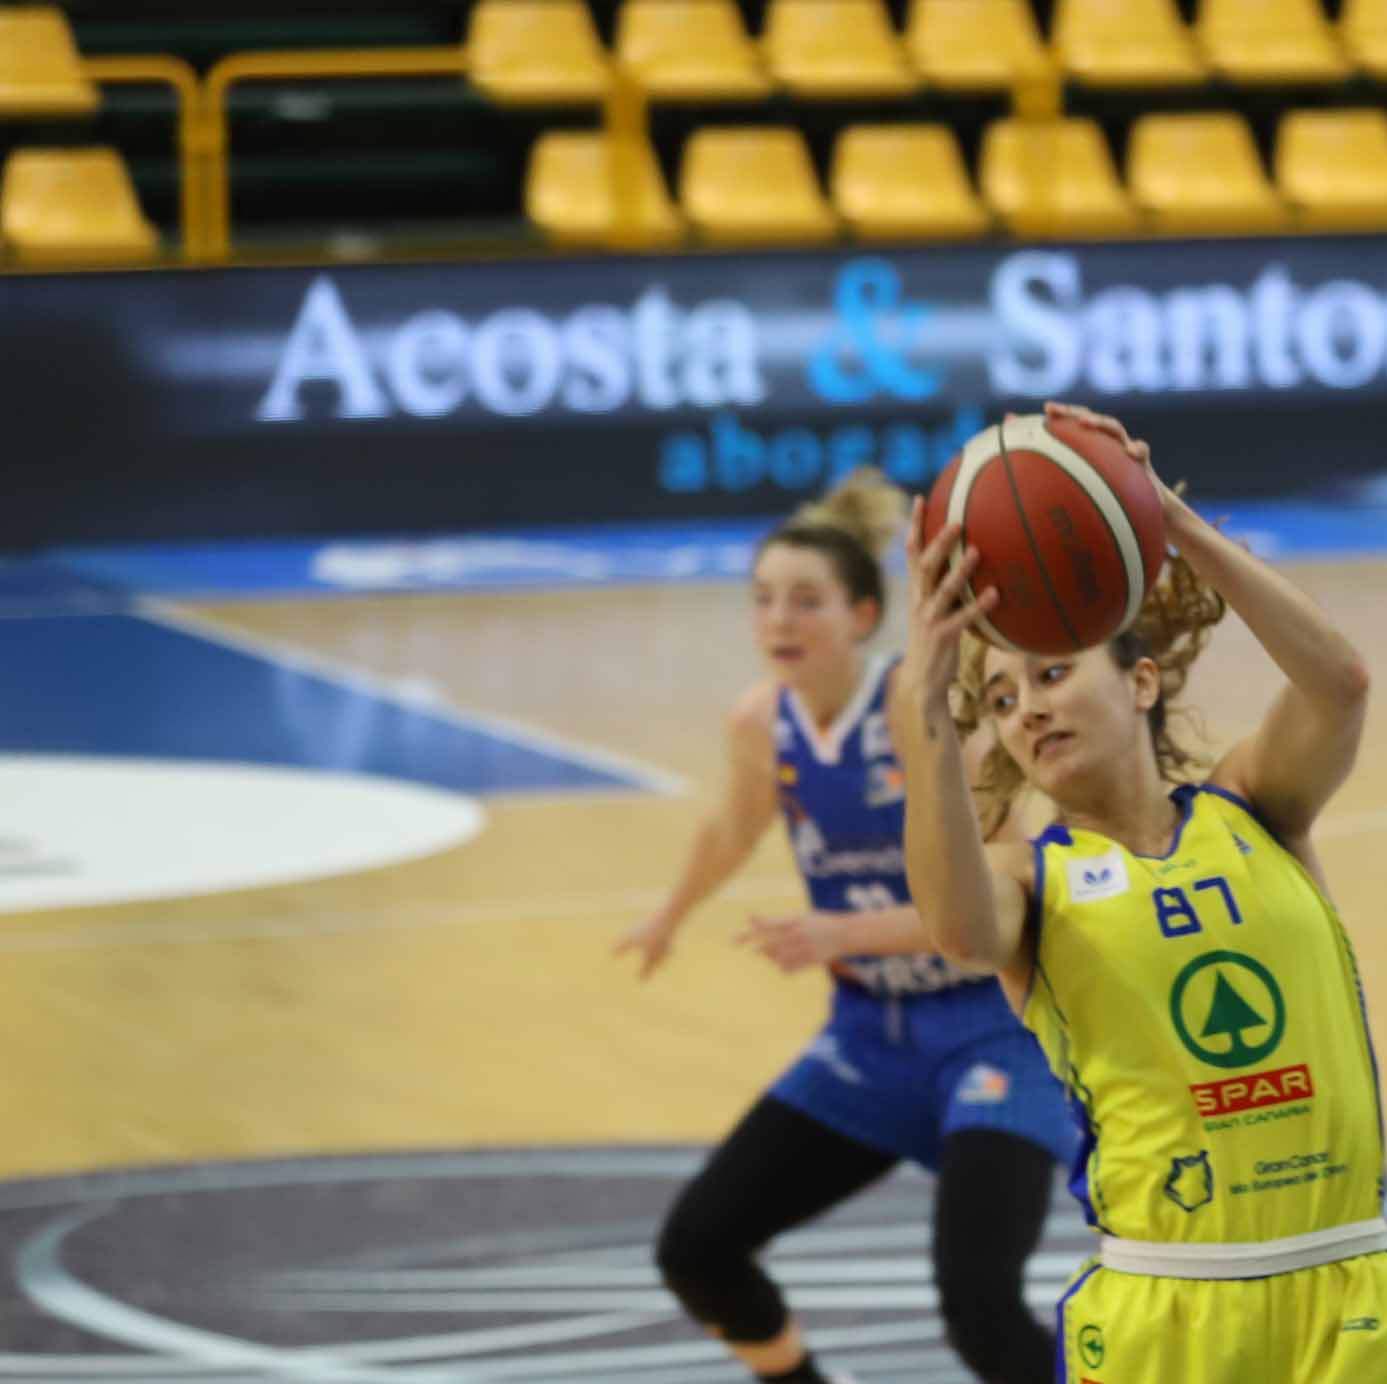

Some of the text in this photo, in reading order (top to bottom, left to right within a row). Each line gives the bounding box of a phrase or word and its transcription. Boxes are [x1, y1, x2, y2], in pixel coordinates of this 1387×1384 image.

[255, 273, 767, 421] Acosta
[807, 255, 941, 403] &
[1152, 877, 1242, 938] 87
[1193, 1070, 1310, 1113] SPAR
